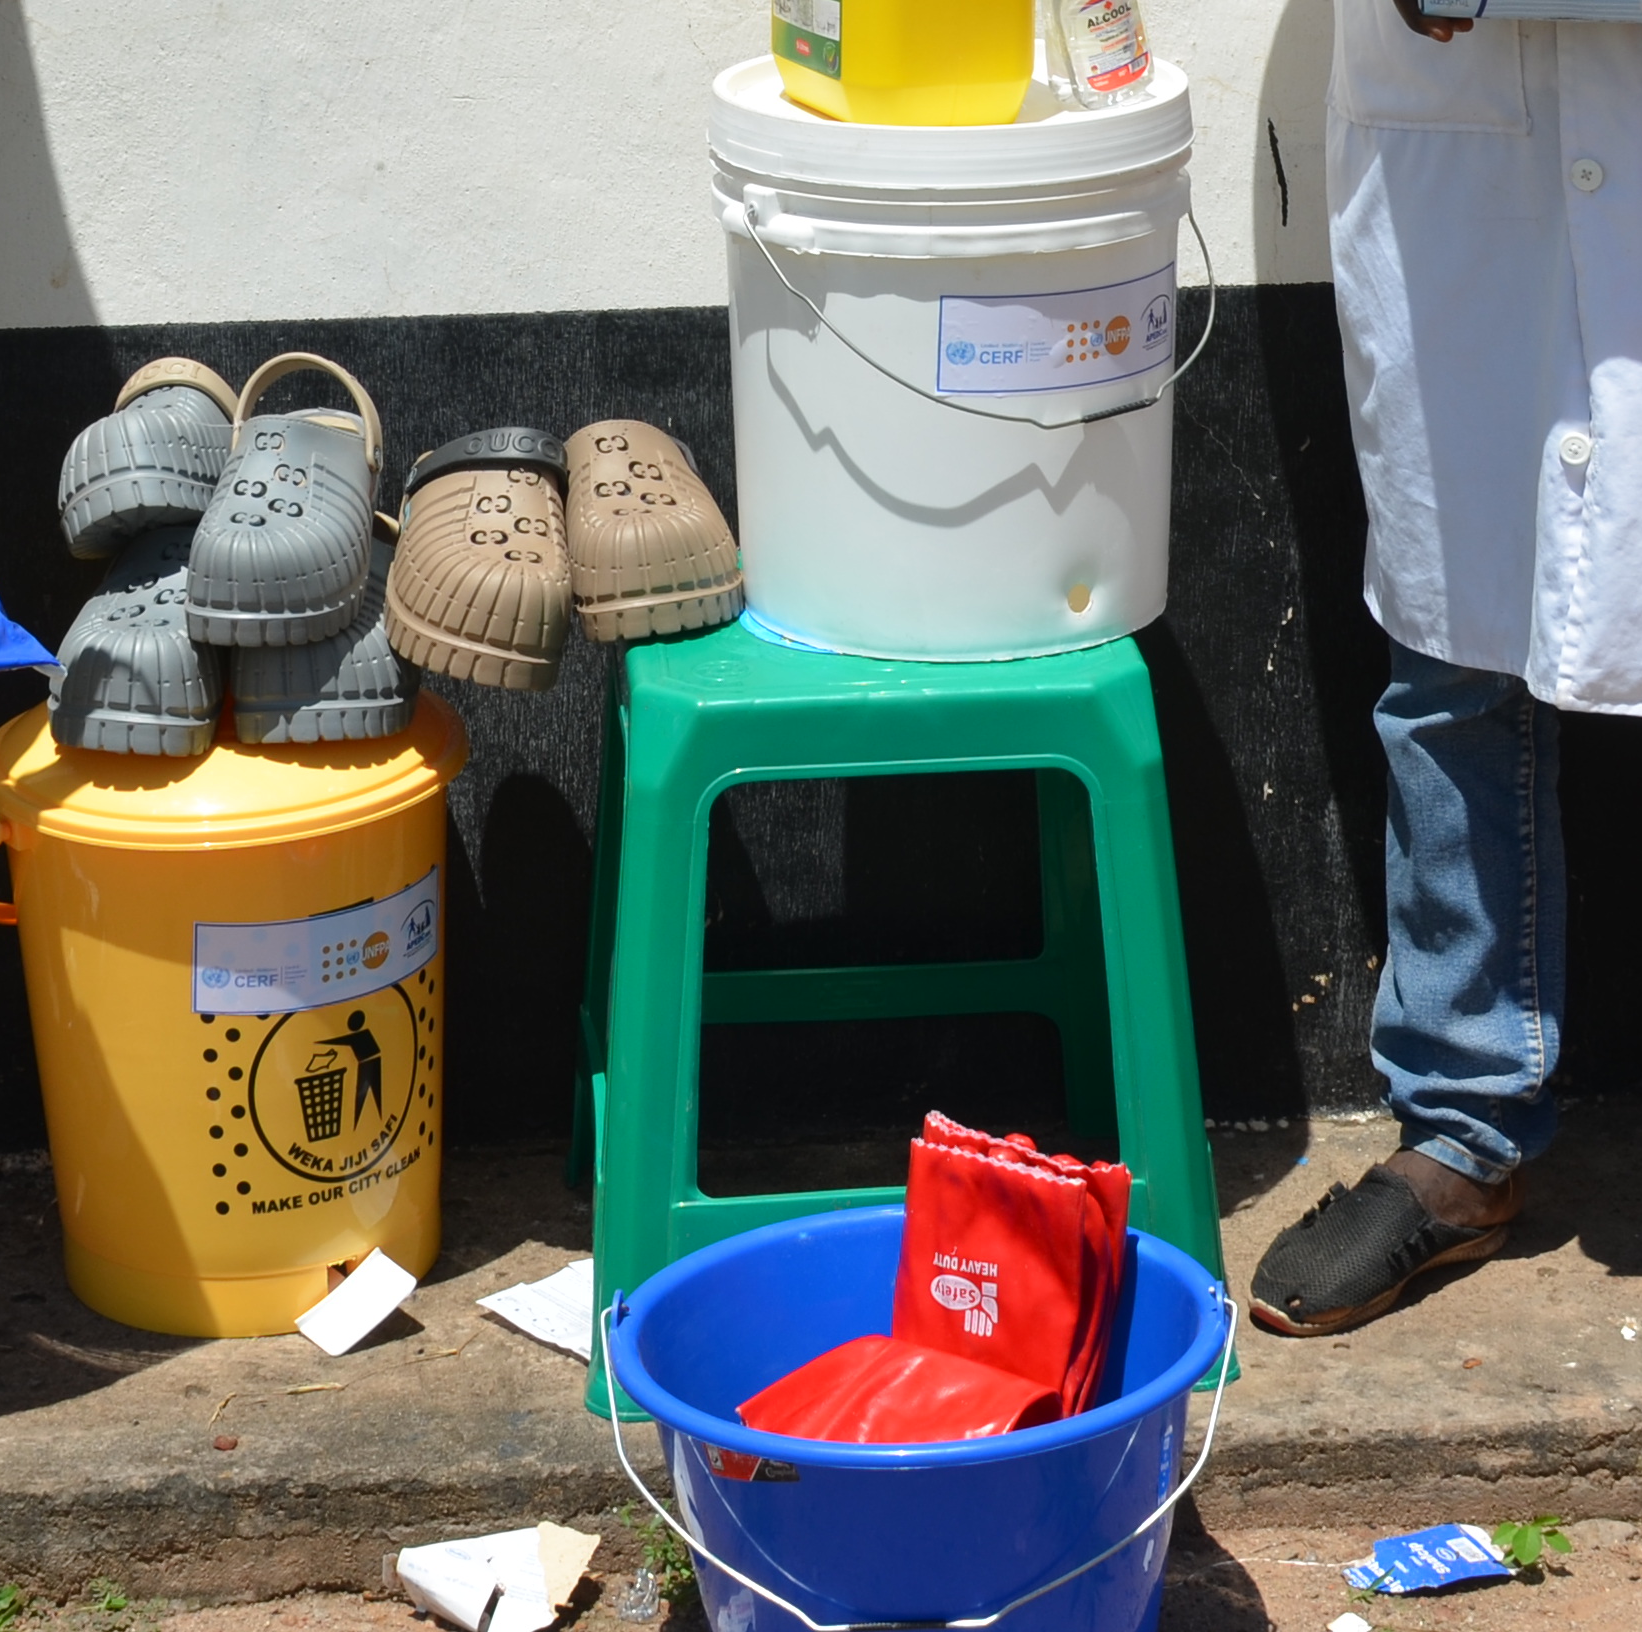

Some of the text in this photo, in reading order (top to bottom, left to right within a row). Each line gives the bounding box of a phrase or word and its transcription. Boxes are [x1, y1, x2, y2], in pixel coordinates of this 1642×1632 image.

[1087, 2, 1132, 28] ALCOOL
[1105, 327, 1131, 345] UNFPA
[979, 349, 1024, 364] CERF
[361, 938, 391, 961] UNFPA
[234, 973, 279, 989] CERF
[287, 1113, 398, 1173] WEKA JIJI SAFI
[251, 1146, 422, 1215] MAKE OUR CITY CLEAN
[933, 1252, 998, 1277] HEAVY DUTY
